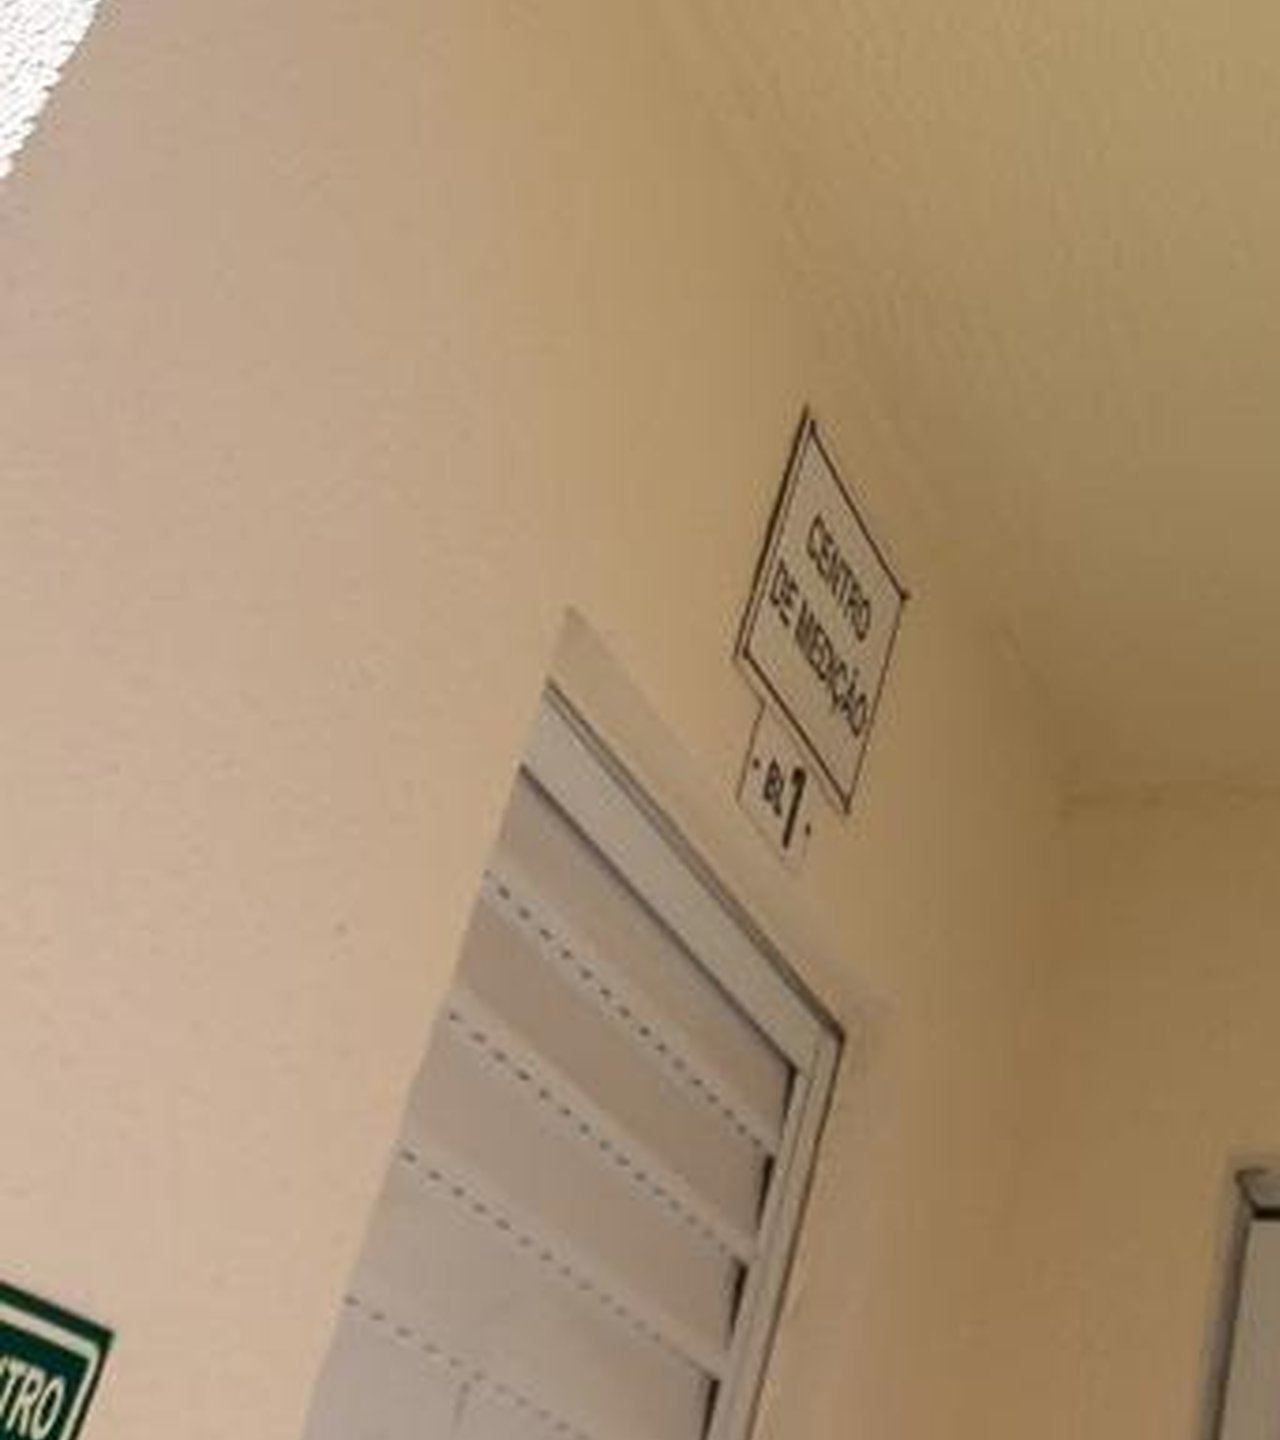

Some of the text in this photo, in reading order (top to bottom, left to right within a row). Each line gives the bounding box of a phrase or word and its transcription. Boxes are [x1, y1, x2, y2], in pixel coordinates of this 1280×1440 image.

[806, 514, 871, 642] CENTRO
[769, 557, 868, 737] DE MEDIÇÃO
[0, 1356, 65, 1440] TRO
